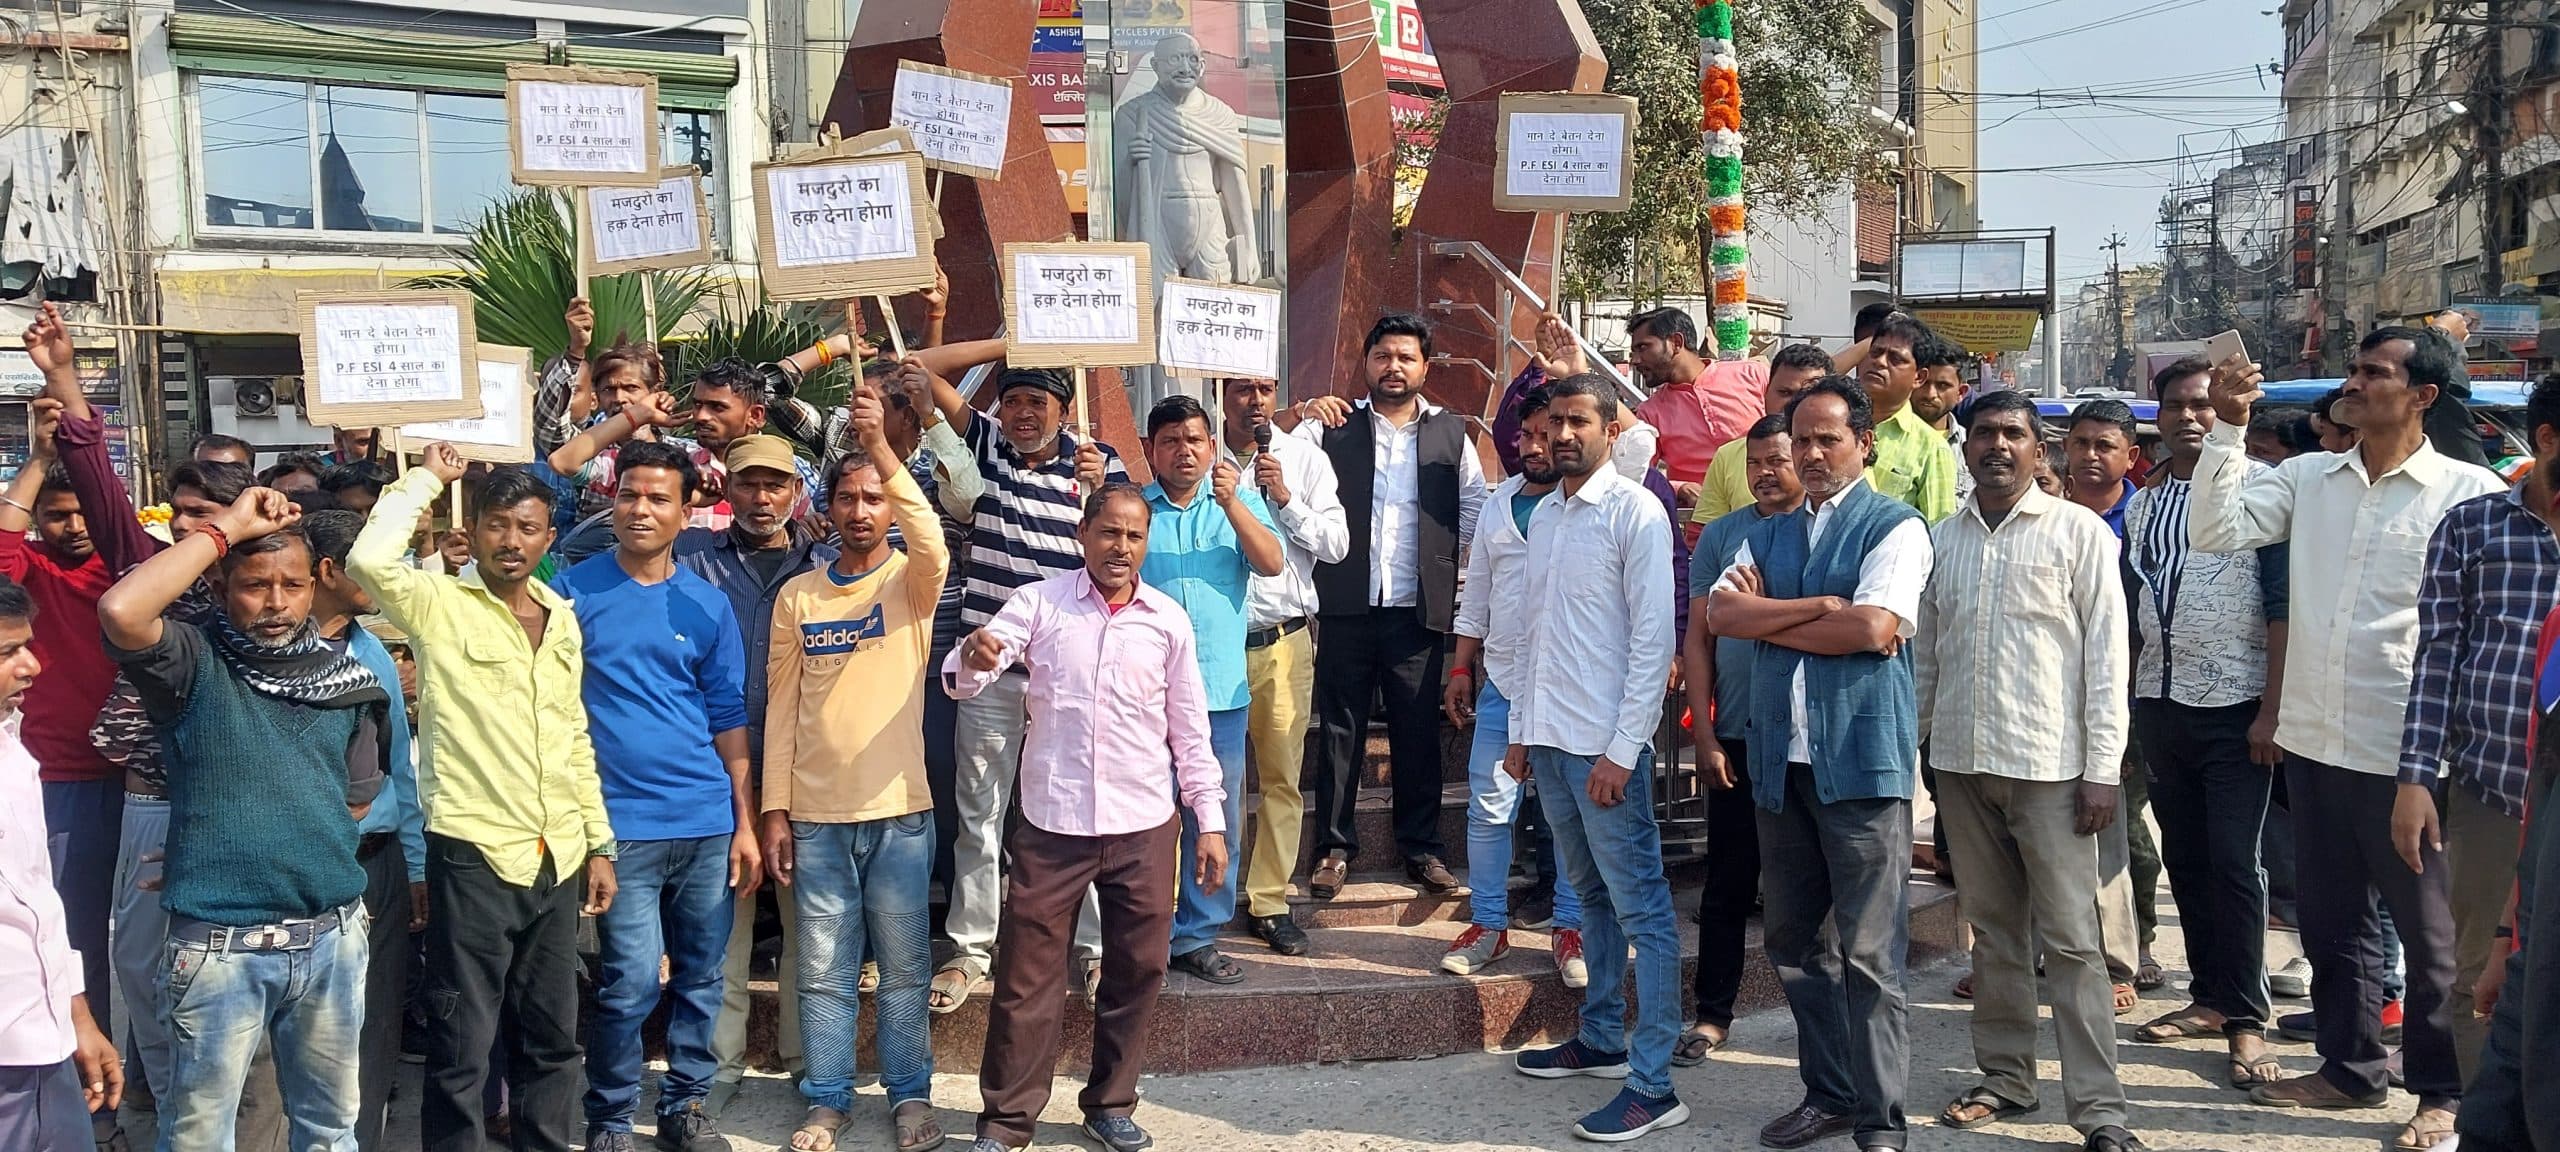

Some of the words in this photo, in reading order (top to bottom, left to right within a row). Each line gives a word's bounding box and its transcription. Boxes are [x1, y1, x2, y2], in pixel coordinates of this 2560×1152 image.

[1049, 28, 1080, 37] ASHISH
[1113, 28, 1148, 37] CYCLES
[1029, 73, 1056, 87] XIS
[564, 103, 572, 114] दे
[605, 104, 625, 116] देना
[934, 92, 942, 104] दे
[976, 98, 994, 112] देना
[902, 119, 920, 131] P.F
[925, 122, 941, 134] ESI
[947, 127, 954, 137] 4
[957, 129, 977, 141] साल
[983, 133, 996, 145] का
[1549, 130, 1556, 141] दे
[1587, 130, 1605, 141] देना
[536, 135, 553, 145] P.F
[559, 135, 576, 145] ESI
[582, 135, 589, 145] 4
[592, 137, 613, 147] साल
[618, 137, 631, 147] का
[925, 136, 943, 150] देना
[949, 139, 970, 154] होगा
[562, 150, 580, 160] देना
[586, 149, 608, 160] होगा
[1520, 160, 1537, 170] P.F
[1542, 160, 1557, 170] ESI
[1562, 160, 1569, 170] 4
[1572, 161, 1591, 170] साल
[1596, 161, 1609, 170] का
[857, 176, 880, 192] का
[1543, 173, 1560, 184] देना
[1565, 173, 1585, 184] होगा
[656, 191, 673, 204] का
[631, 213, 654, 230] देना
[657, 210, 684, 227] होगा
[824, 203, 854, 225] देना
[856, 200, 894, 221] होगा
[1093, 267, 1112, 283] का
[1062, 288, 1088, 309] देना
[1091, 289, 1121, 309] होगा
[1237, 302, 1256, 317] का
[340, 328, 360, 339] मान
[367, 326, 376, 338] दे
[415, 324, 436, 337] देना
[1204, 318, 1231, 338] देना
[1234, 321, 1264, 342] होगा
[336, 362, 355, 374] P.F
[363, 362, 382, 373] ESI
[389, 361, 397, 371] 4
[400, 361, 424, 371] साल
[431, 360, 445, 371] का
[367, 376, 387, 388] देना
[394, 375, 419, 388] होगा
[804, 628, 860, 649] adida
